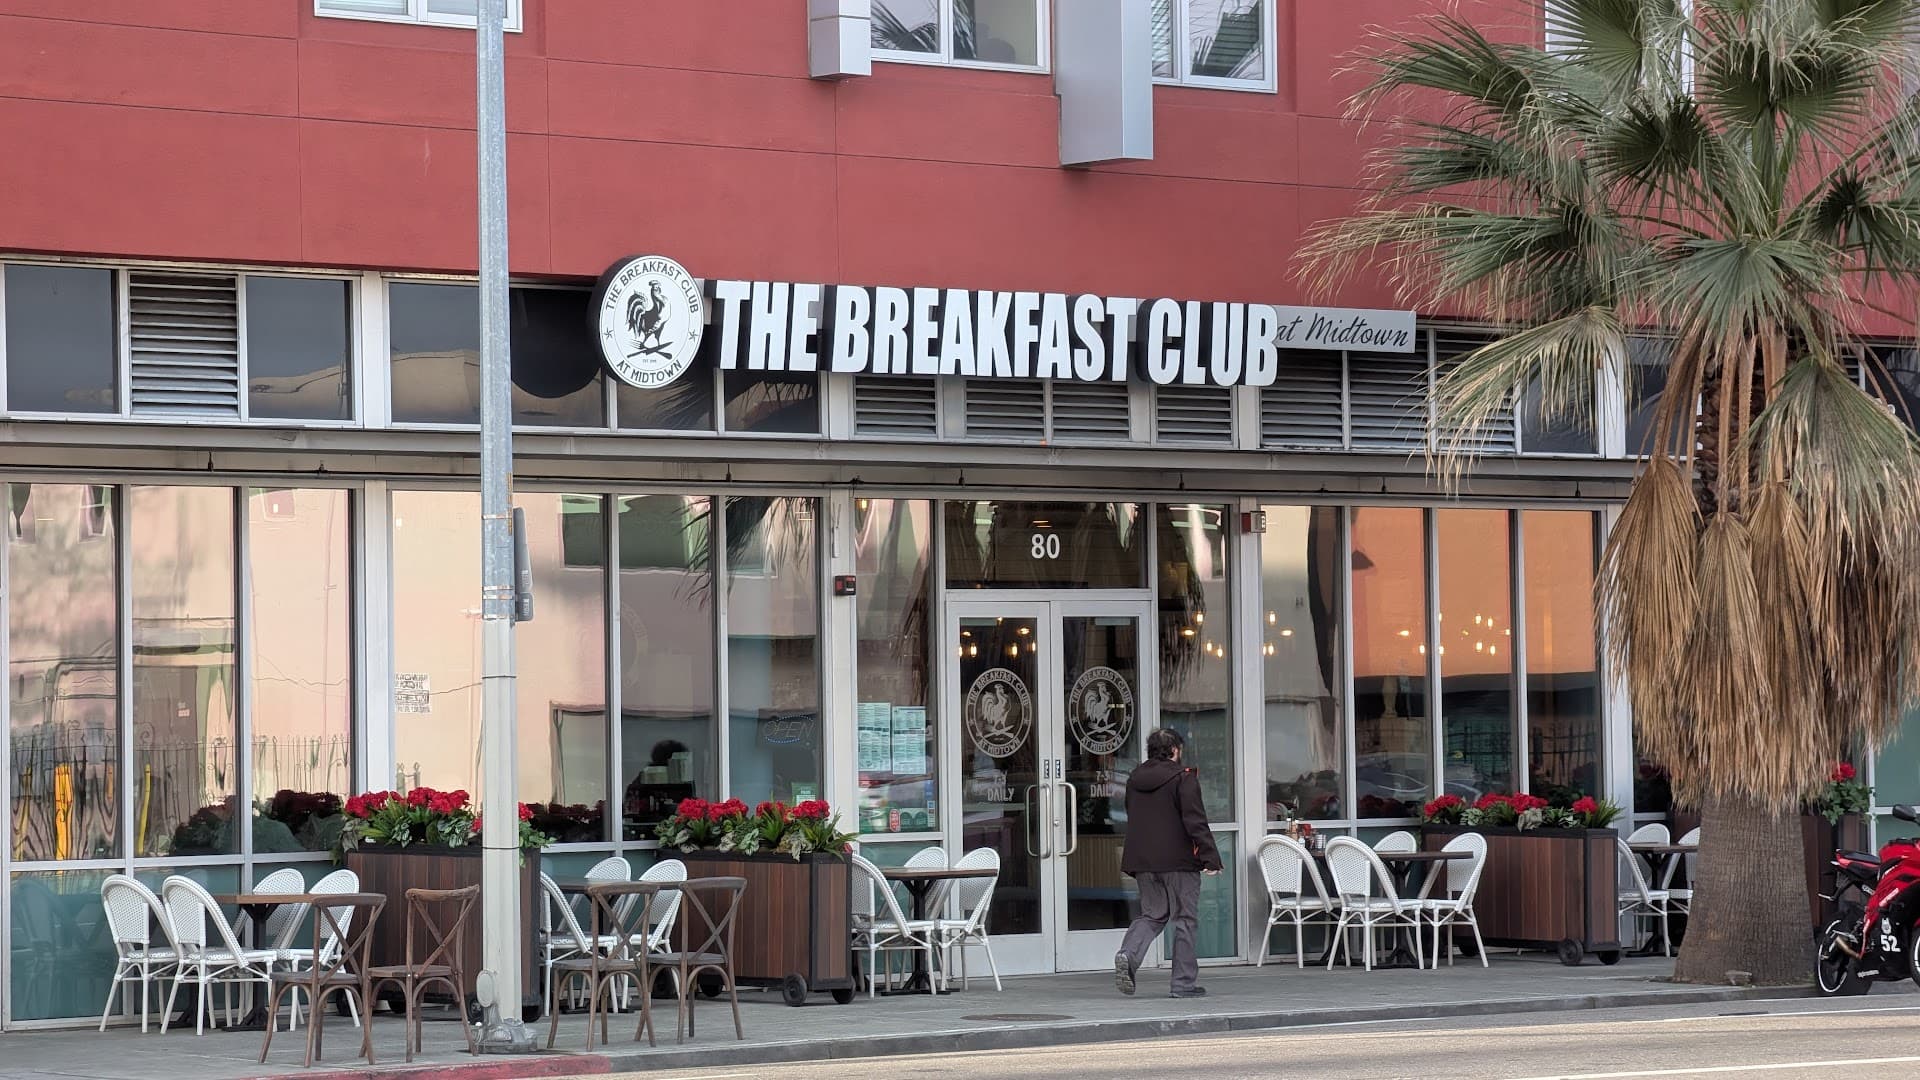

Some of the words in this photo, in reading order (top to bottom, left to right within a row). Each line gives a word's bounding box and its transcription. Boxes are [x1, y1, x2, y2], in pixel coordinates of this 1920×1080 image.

[606, 284, 622, 311] THE
[620, 261, 682, 286] BREAKFAST
[681, 280, 699, 314] CLUB
[716, 280, 820, 371] THE
[831, 285, 1137, 382] BREAKFAST
[1147, 298, 1278, 386] CLUB
[1276, 315, 1303, 342] at
[1305, 312, 1408, 347] Midtown
[616, 360, 631, 375] AT
[630, 359, 682, 383] MIDTOWN
[1031, 533, 1060, 559] 80
[968, 687, 979, 705] THE
[976, 671, 1017, 689] BREAKFAST
[1016, 682, 1029, 706] CLUB
[1079, 670, 1118, 687] BREAKFAST
[763, 720, 815, 738] OPEN
[987, 787, 1015, 802] DAILY
[1880, 934, 1901, 952] 52
